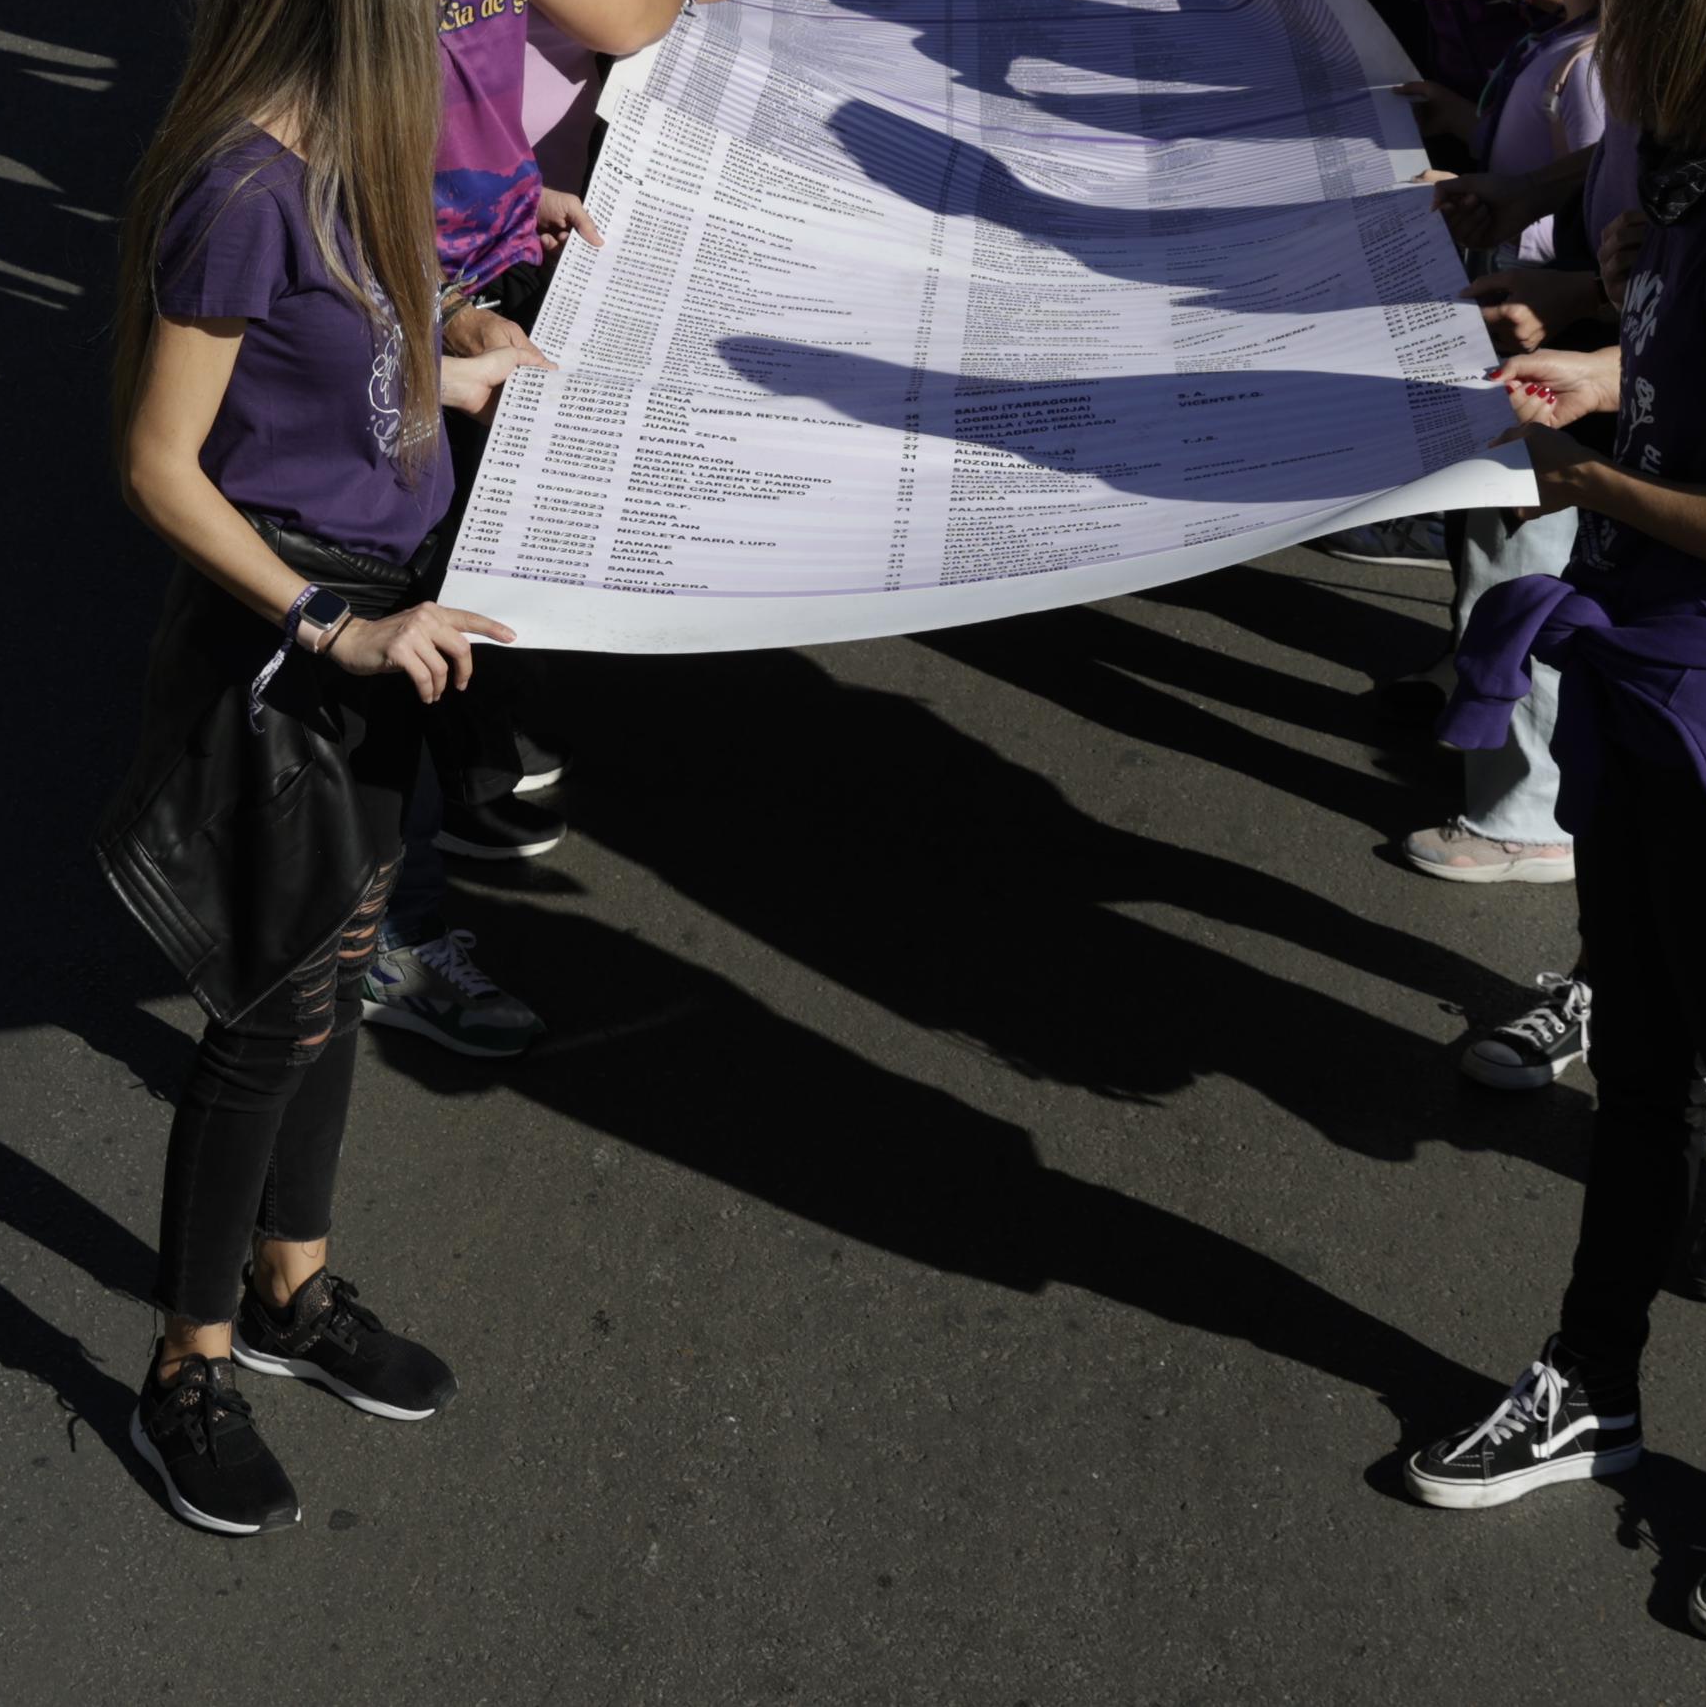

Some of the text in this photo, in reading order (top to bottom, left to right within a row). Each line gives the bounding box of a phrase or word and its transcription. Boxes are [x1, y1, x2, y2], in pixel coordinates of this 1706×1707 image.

[440, 1, 475, 32] cia
[603, 159, 644, 187] 2023
[509, 386, 542, 395] 1.393
[562, 394, 630, 407] 07/08/2023
[513, 371, 692, 403] 1.391 30/07/2023 ELENA
[1427, 374, 1479, 387] PAREJA
[506, 394, 690, 426] 1.394 07/08/2023 ZHOUR
[511, 379, 545, 387] 1.392
[565, 386, 632, 399] 31/07/2023
[647, 398, 687, 411] ERICA
[691, 407, 752, 417] VANESSA
[756, 412, 799, 421] REYES
[954, 396, 1091, 415] SALOU (TARRAGONA)
[501, 412, 705, 448] 1.396 08/08/2023 EVARISTA
[504, 401, 737, 441] 1.395 08/08/2023 JUANA ZEPAS
[955, 412, 1018, 425] LOGROÑO
[955, 422, 1013, 433] ANTELLA
[495, 431, 530, 441] 1.398
[550, 441, 618, 456] 30/08/2023
[634, 455, 694, 467] ROSARIO
[754, 471, 832, 483] CHAMORRO
[497, 424, 734, 465] 1.397 23/08/2023 ENCARNACIÓN
[487, 459, 521, 467] 1.401
[542, 468, 612, 482] 03/09/2023
[689, 486, 718, 494] CON
[722, 490, 780, 500] NOMBRE
[490, 447, 806, 496] 1.400 03/09/2023 MARCIEL GARCÍA VALMEO
[493, 439, 811, 489] 1.399 30/08/2023 RAQUEL LLARENTE PARDO
[953, 458, 1045, 471] POZOBLANCO
[478, 486, 678, 520] 1.403 11/09/2023 SANDRA
[482, 474, 517, 484] 1.402
[537, 484, 608, 498] 05/09/2023
[624, 497, 661, 506] ROSA
[627, 485, 726, 502] DESCONOCIDO
[472, 506, 508, 516] 1.405
[529, 515, 600, 529] 15/09/2023
[616, 527, 686, 540] NICOLETA
[476, 494, 700, 530] 1.404 15/09/2023 SUZAN ANN
[467, 526, 659, 556] 1.407 17/09/2023 LAURA
[469, 517, 672, 549] 1.406 16/09/2023 HANANE
[460, 545, 665, 575] 1.409 28/09/2023 SANDRA
[464, 534, 674, 565] 1.408 24/09/2023 MIGUELA
[453, 565, 676, 595] 1.411 04/11/2023 CAROLINA
[456, 557, 709, 589] 1.410 10/10/2023 PAQUI LOPERA
